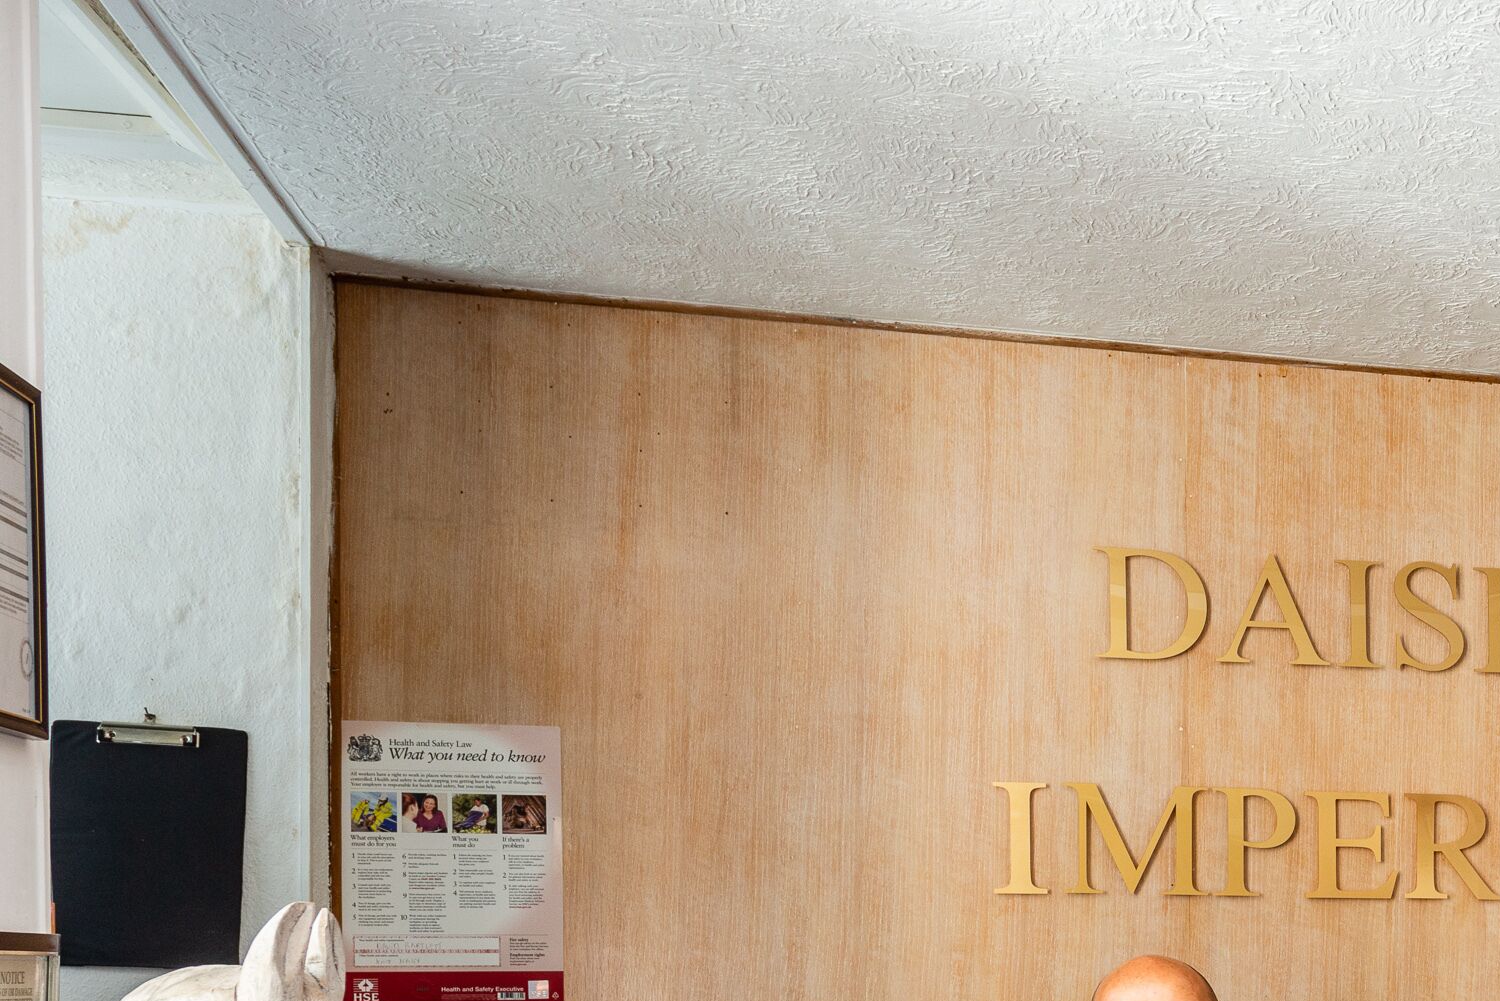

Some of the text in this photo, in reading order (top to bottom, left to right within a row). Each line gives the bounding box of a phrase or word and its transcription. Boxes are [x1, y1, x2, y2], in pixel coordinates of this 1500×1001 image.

[389, 738, 414, 746] Health
[432, 740, 454, 749] Safety
[389, 748, 546, 763] What you need to know
[0, 971, 24, 984] NOTICE
[353, 993, 379, 1001] HSE
